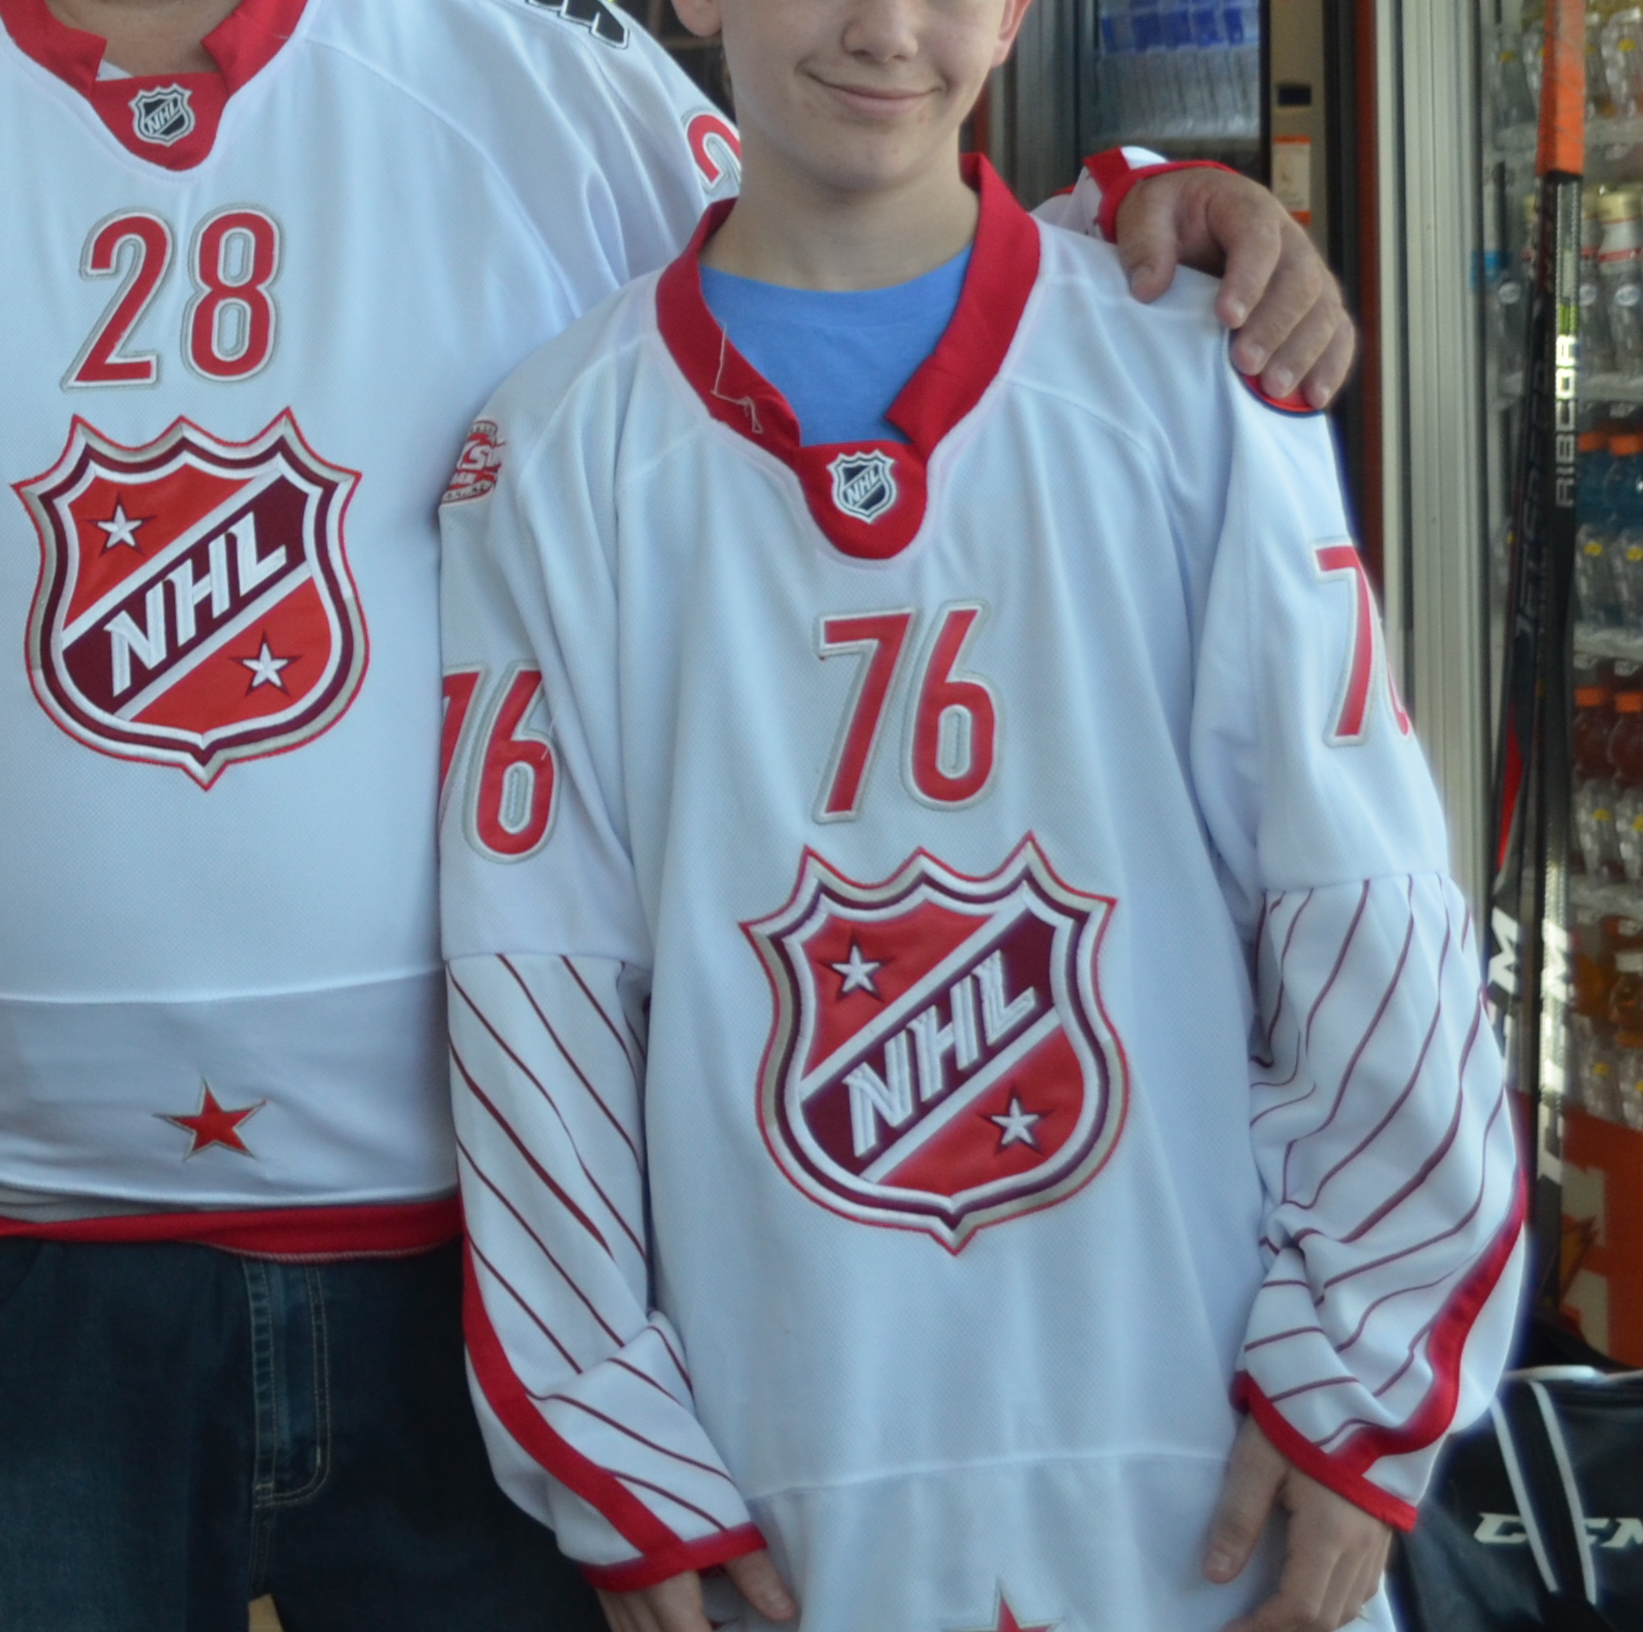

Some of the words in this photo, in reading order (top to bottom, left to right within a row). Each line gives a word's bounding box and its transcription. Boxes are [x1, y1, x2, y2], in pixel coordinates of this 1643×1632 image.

[146, 99, 180, 136] NHL
[61, 205, 281, 391] 28
[845, 468, 880, 507] NHL
[1555, 333, 1577, 507] RIBCOR
[103, 511, 288, 698] NHL
[439, 661, 563, 864] 76
[813, 601, 1002, 823] 76
[842, 948, 1036, 1160] NHL
